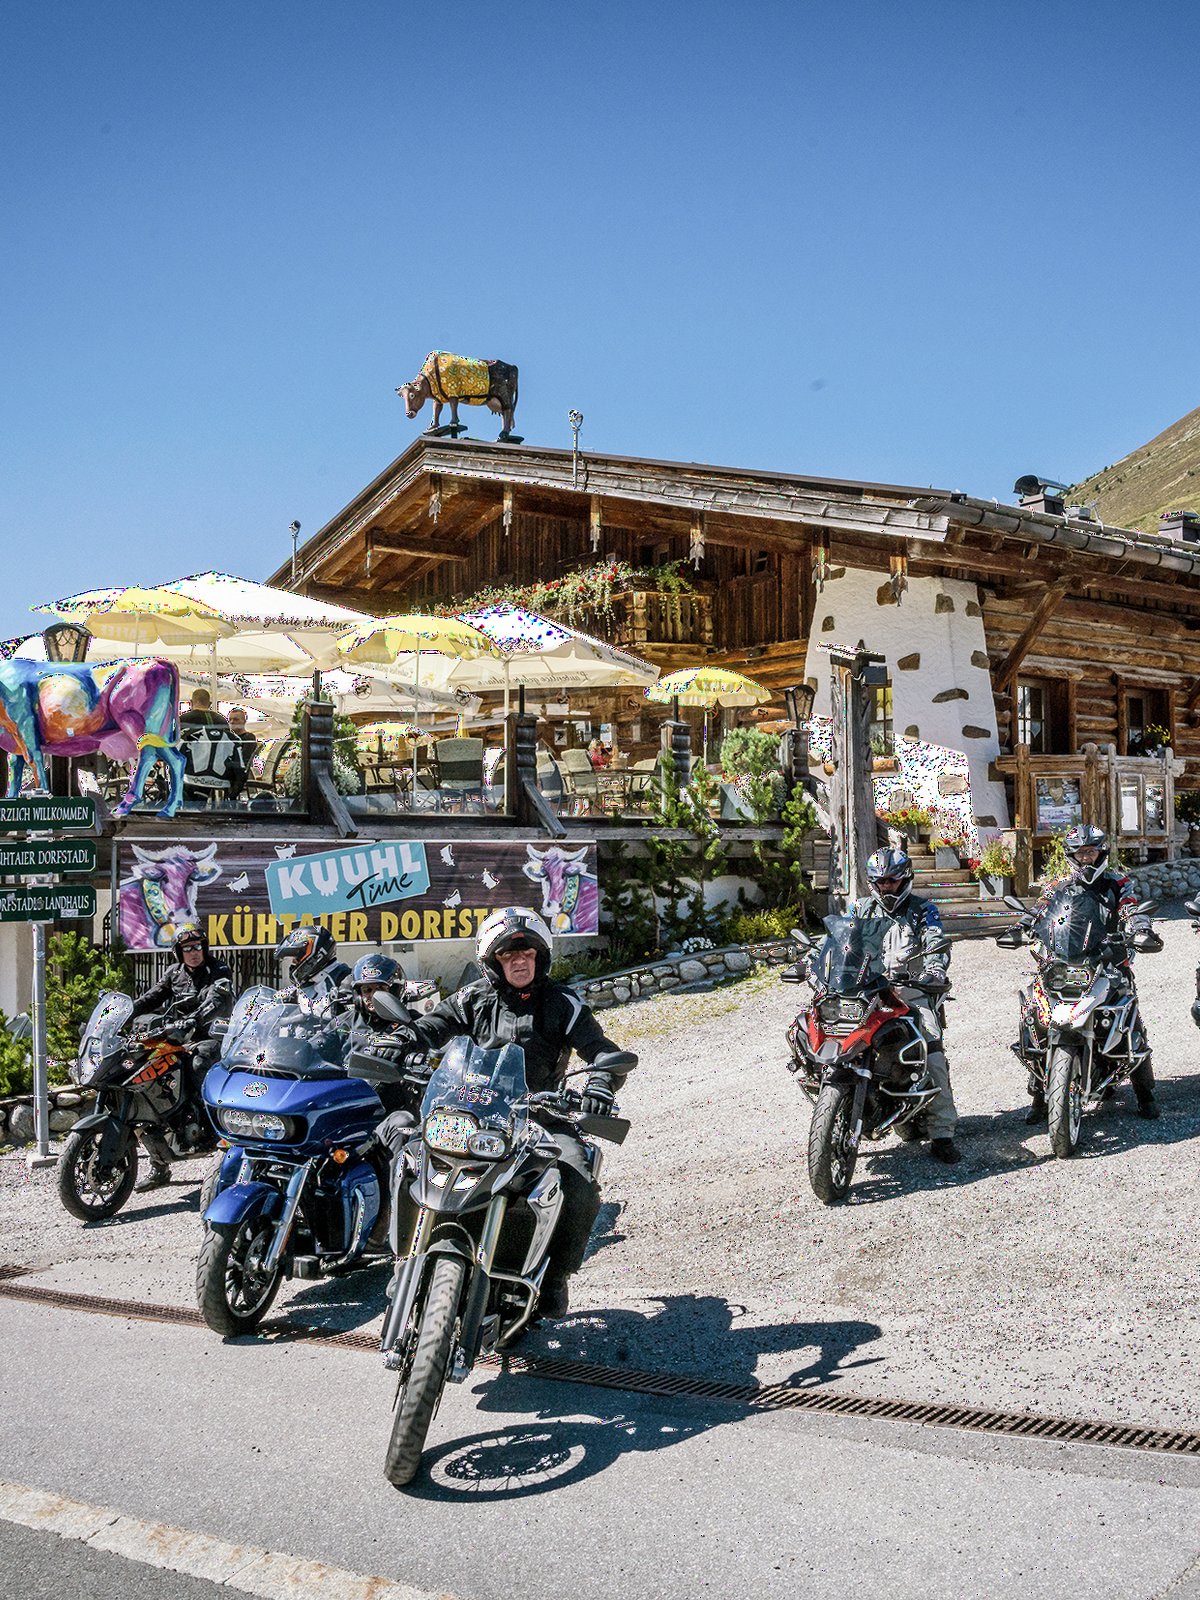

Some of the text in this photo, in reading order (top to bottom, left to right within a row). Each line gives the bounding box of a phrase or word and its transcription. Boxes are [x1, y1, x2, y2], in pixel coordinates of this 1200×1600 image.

[32, 806, 89, 820] WILLKOMMEN
[38, 850, 89, 864] DORFSTADL
[278, 844, 421, 899] KUUHL
[346, 873, 413, 907] Time
[45, 896, 89, 909] LANDHAUS
